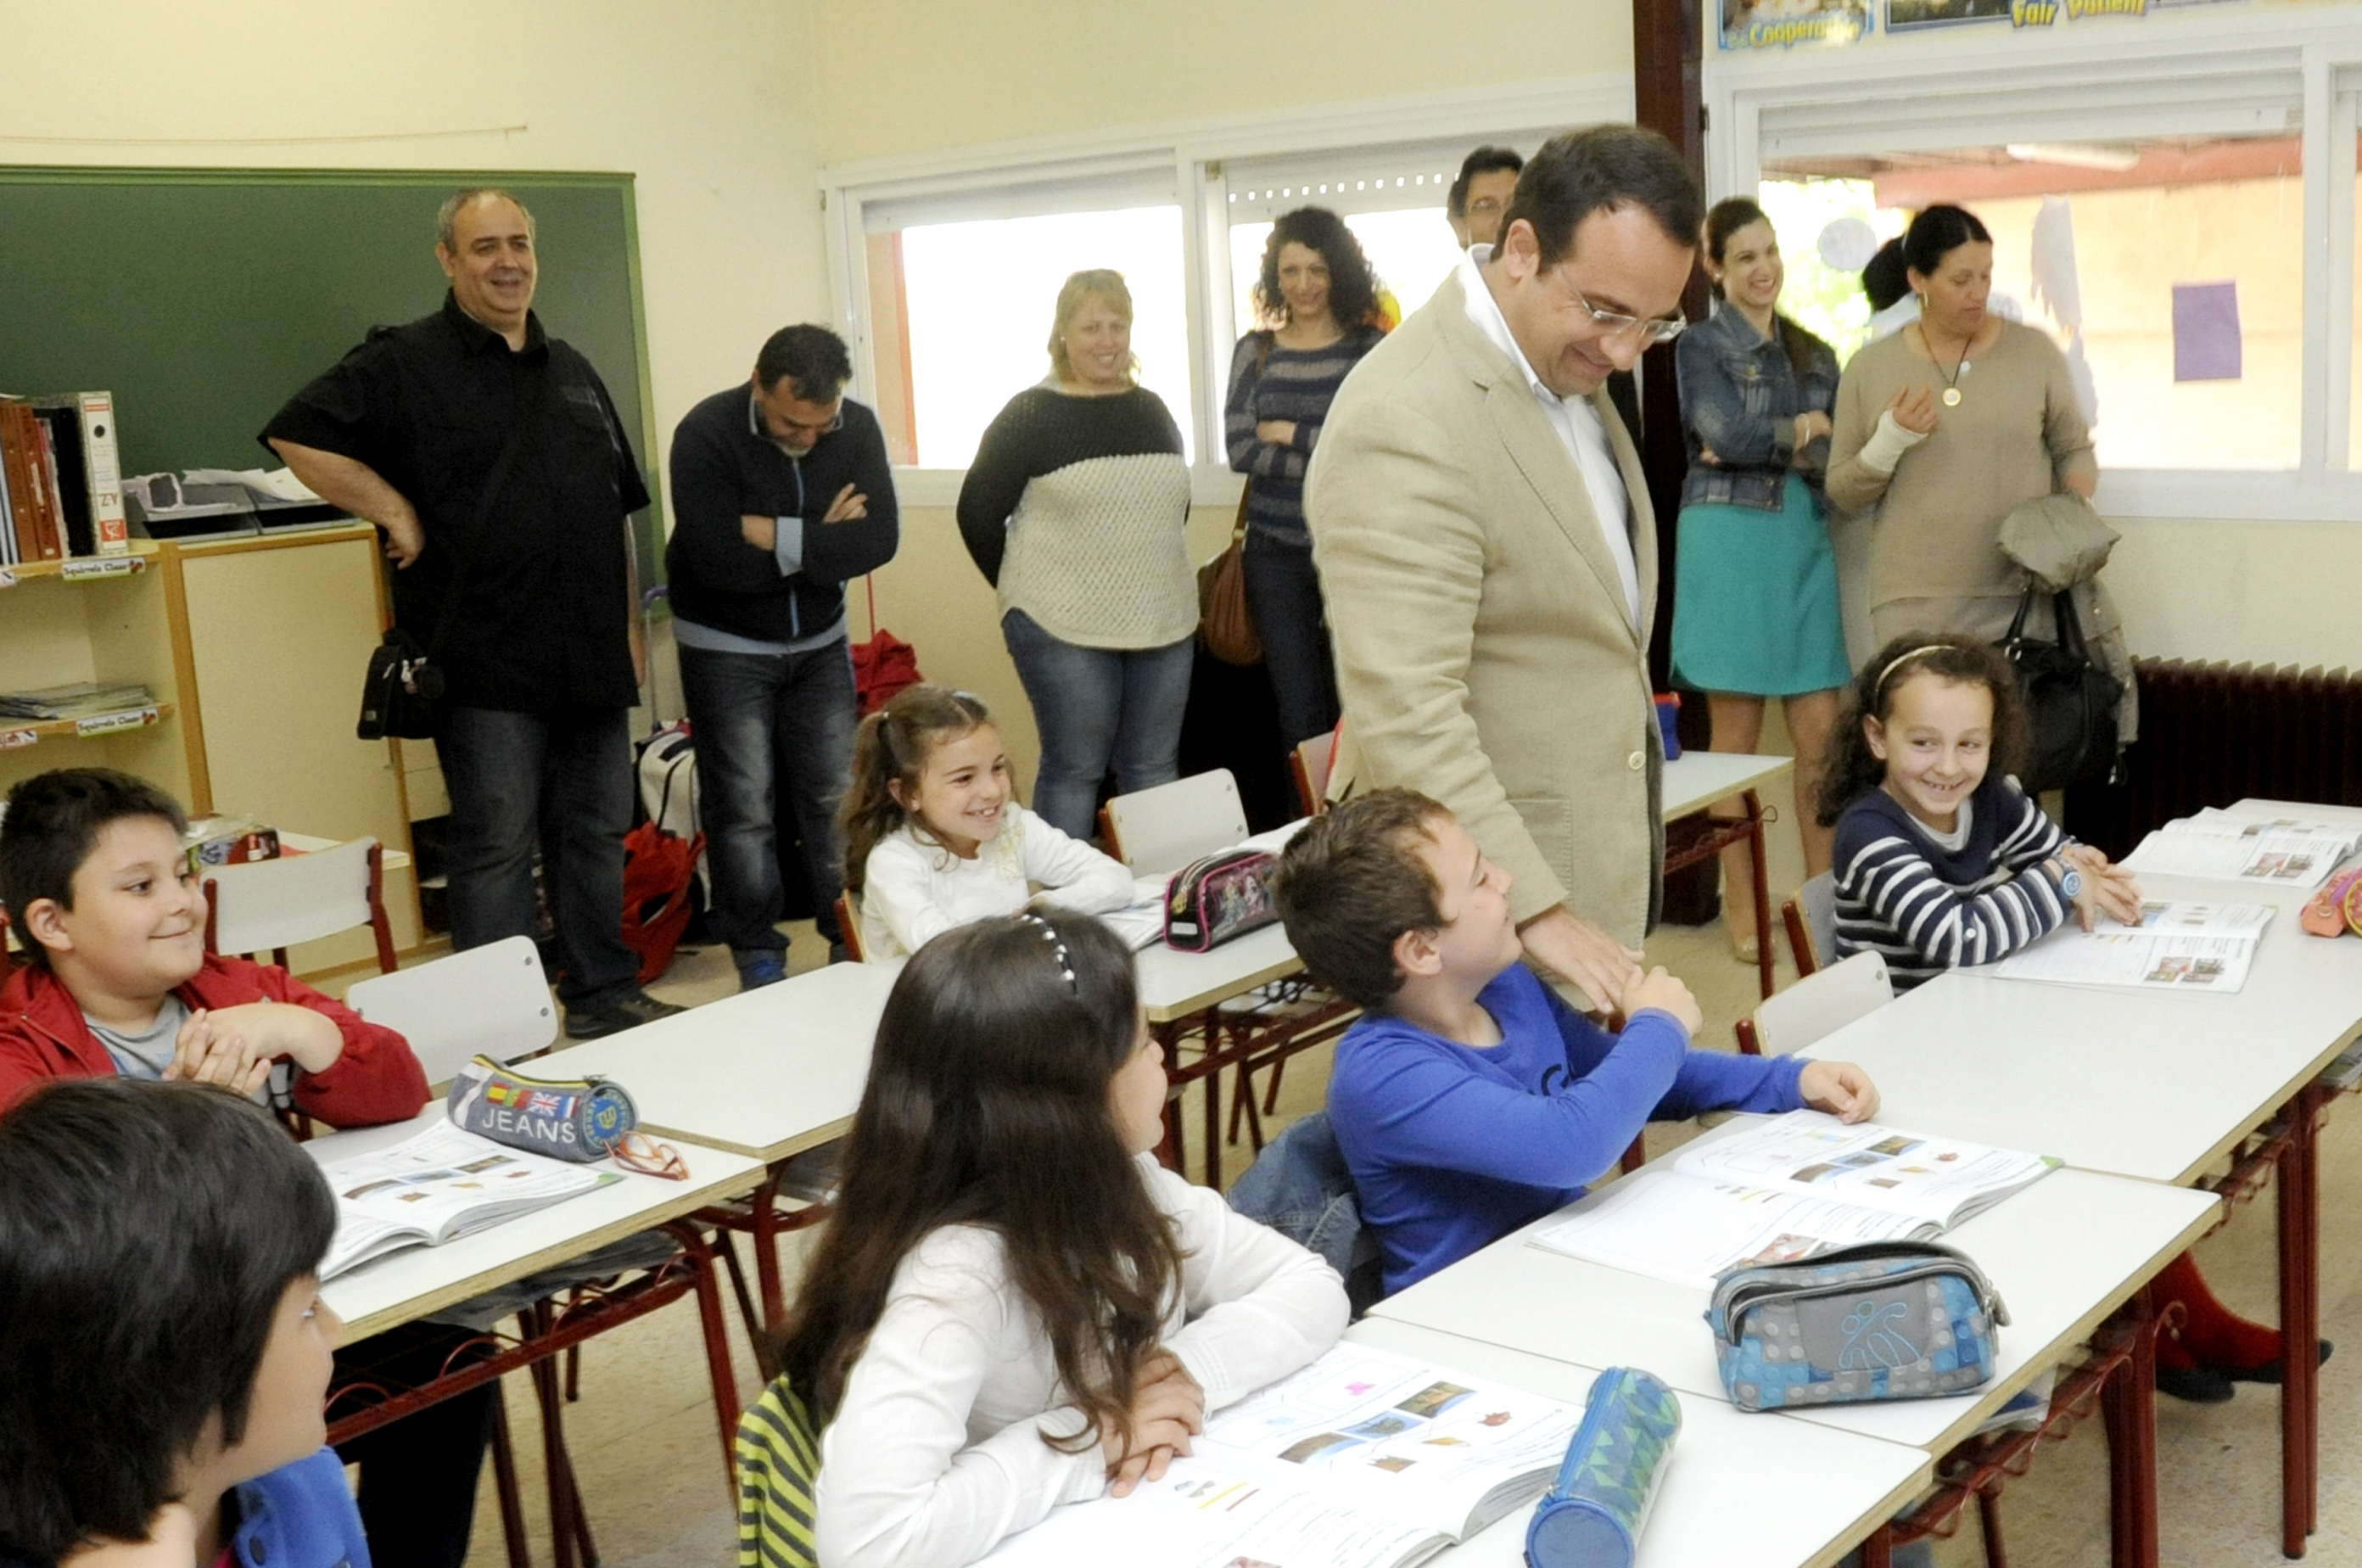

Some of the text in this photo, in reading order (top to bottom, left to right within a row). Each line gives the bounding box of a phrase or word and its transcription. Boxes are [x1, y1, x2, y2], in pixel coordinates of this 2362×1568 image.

[2012, 0, 2058, 27] Fair
[1749, 19, 1860, 48] Cooperae
[482, 1108, 576, 1144] JEANS
